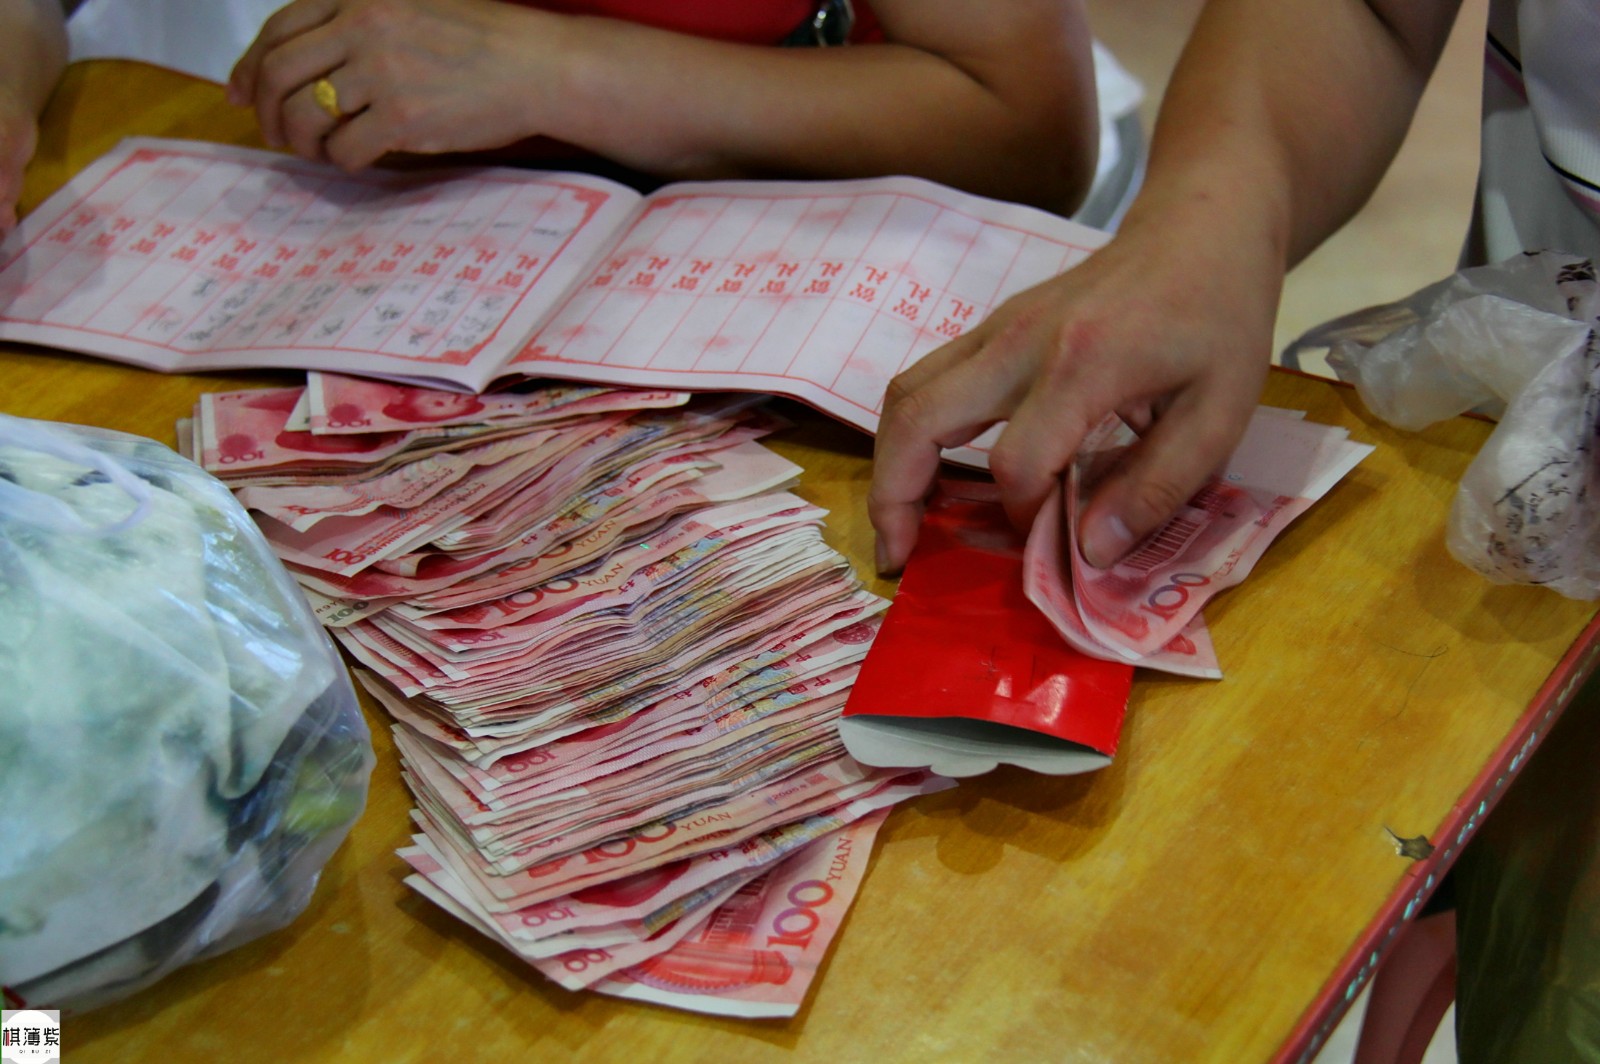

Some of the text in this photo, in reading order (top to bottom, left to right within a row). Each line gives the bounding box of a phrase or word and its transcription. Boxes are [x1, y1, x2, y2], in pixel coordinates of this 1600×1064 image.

[497, 254, 540, 288] 贺礼
[629, 256, 670, 287] 贺礼
[672, 260, 713, 291] 贺礼
[715, 262, 756, 293] 贺礼
[759, 262, 799, 293] 贺礼
[803, 262, 843, 294] 贺礼
[849, 266, 889, 302] 贺礼
[893, 280, 932, 321] 贺礼
[935, 298, 975, 339] 贺礼
[327, 418, 373, 428] 100
[219, 451, 265, 464] 100
[576, 519, 617, 548] YUAN
[320, 547, 366, 565] 100
[494, 579, 580, 617] 100
[582, 563, 624, 588] YUAN
[1138, 573, 1211, 623] 100
[326, 601, 369, 623] 100
[456, 631, 508, 644] 100
[505, 750, 558, 773] 100
[680, 811, 732, 832] YUAN
[766, 838, 854, 950] 100 YUAN
[522, 906, 576, 927] 100
[563, 947, 613, 973] 100
